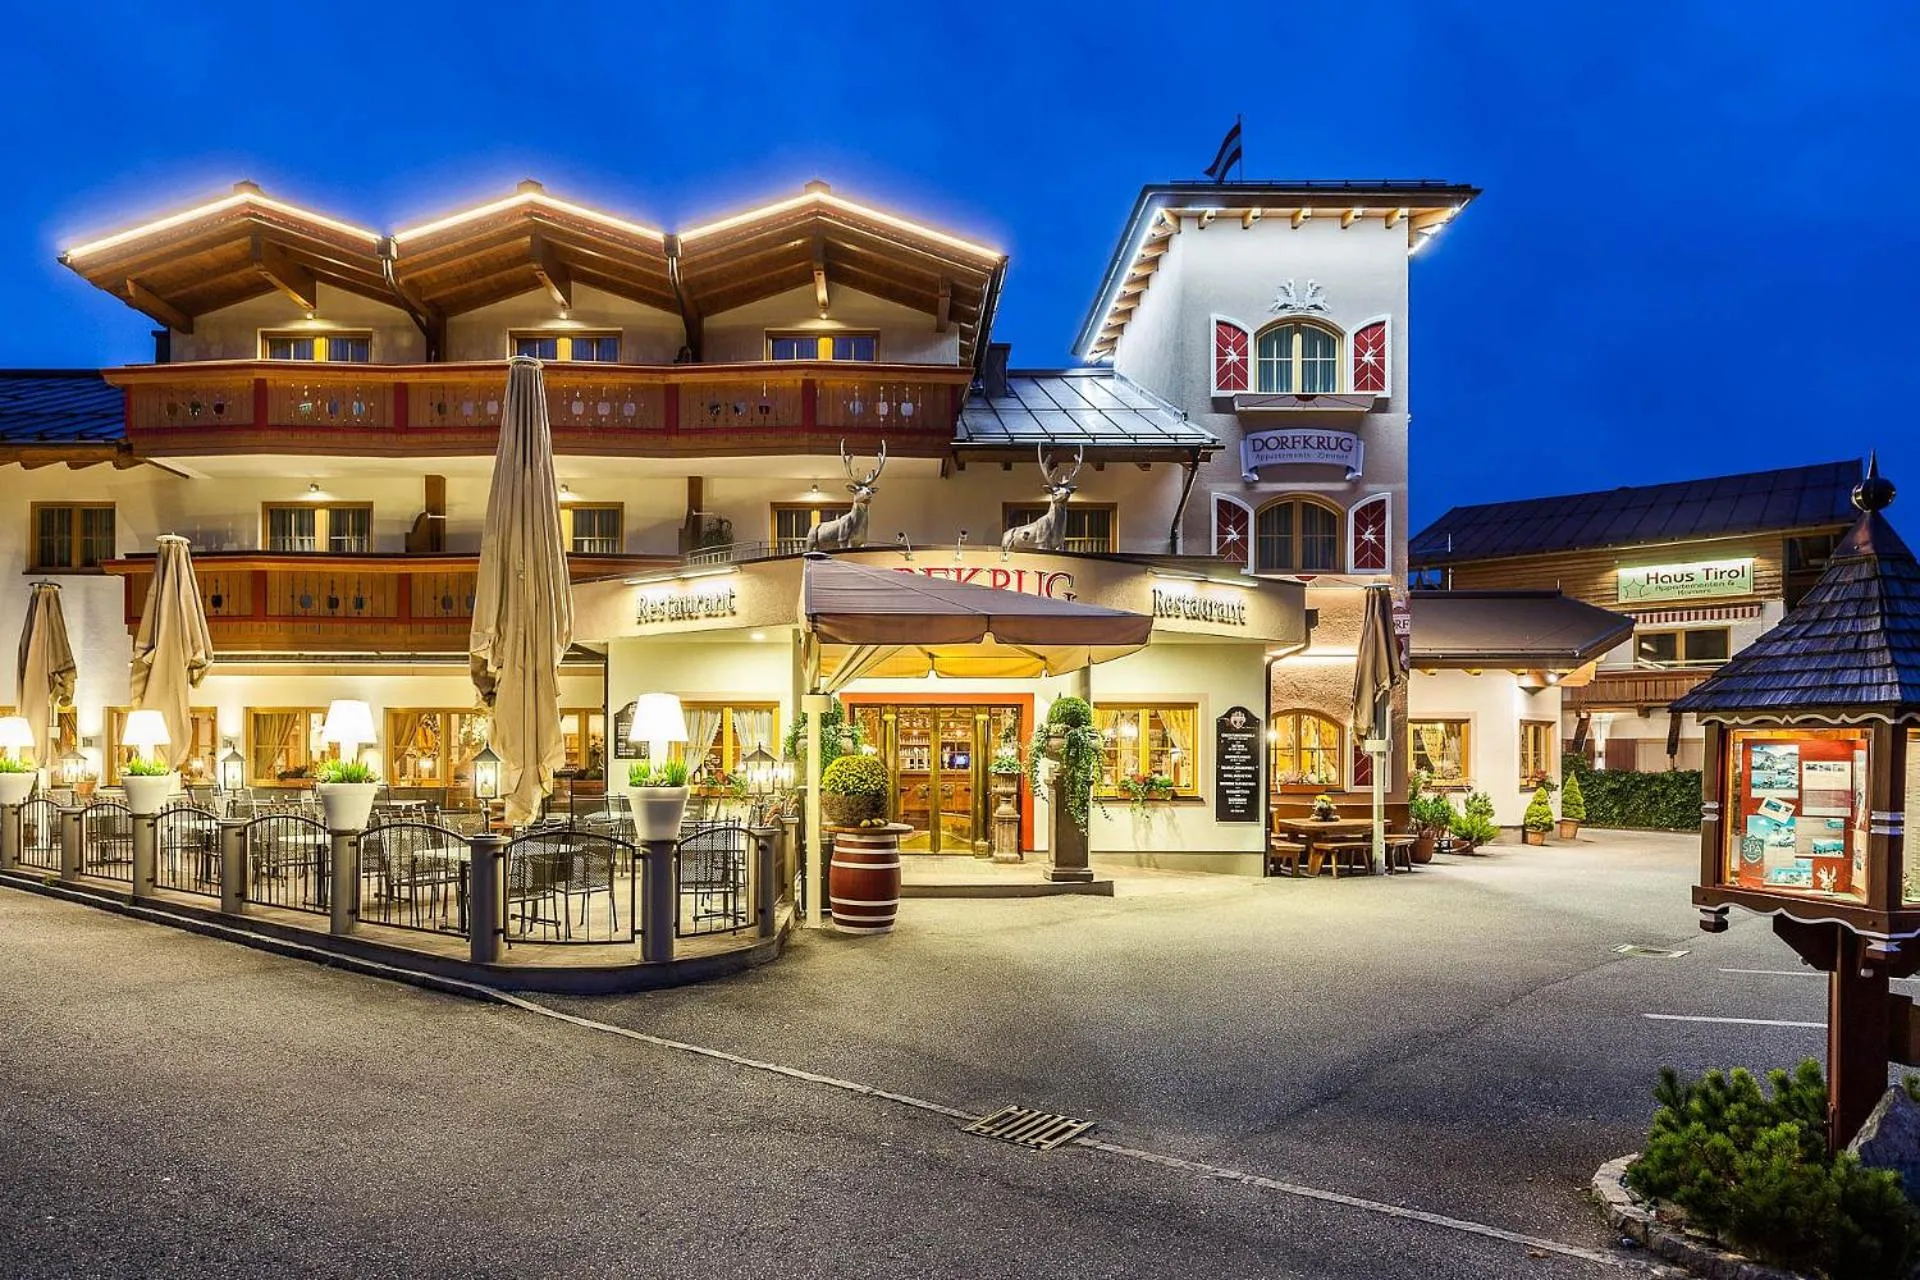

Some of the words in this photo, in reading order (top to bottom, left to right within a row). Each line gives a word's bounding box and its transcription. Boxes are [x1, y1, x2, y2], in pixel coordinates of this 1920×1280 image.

[1252, 435, 1353, 452] DORFKRUG
[1646, 572, 1695, 584] Haus
[1701, 565, 1745, 581] Tirol
[637, 587, 736, 622] Restaurant
[1152, 589, 1246, 623] Restaurant
